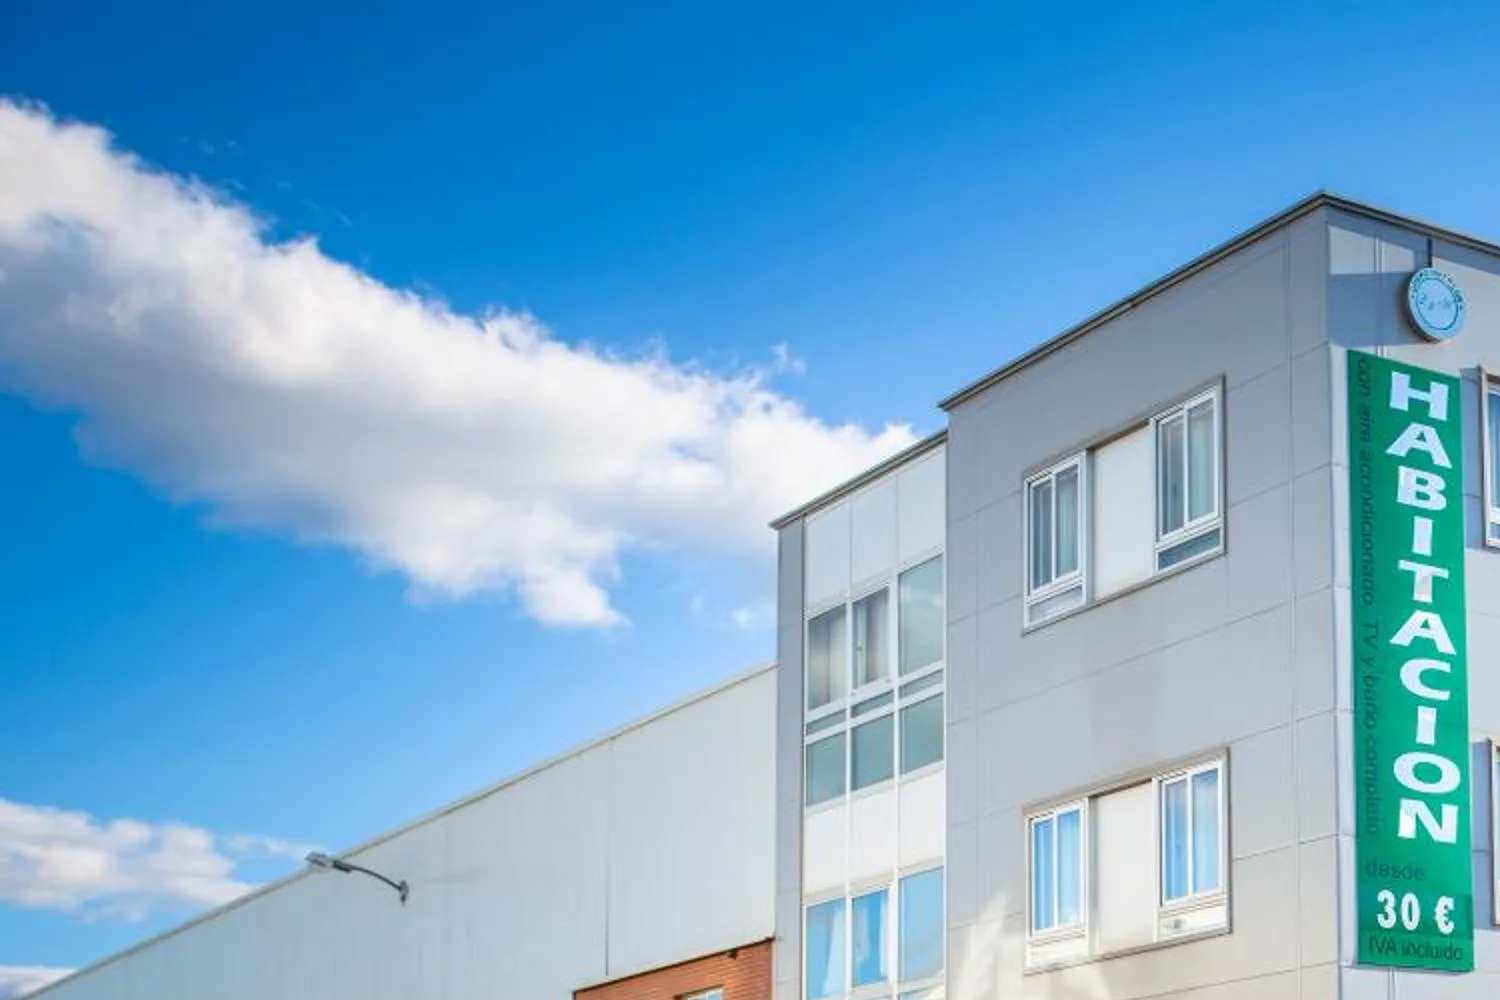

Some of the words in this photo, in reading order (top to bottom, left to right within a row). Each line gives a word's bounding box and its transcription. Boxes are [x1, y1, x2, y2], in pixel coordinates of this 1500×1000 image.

[1385, 371, 1461, 844] HABITACION
[1361, 621, 1379, 650] TV
[1365, 859, 1424, 880] desde
[1376, 889, 1420, 931] 30
[1434, 895, 1455, 935] €
[1368, 935, 1398, 957] IVA
